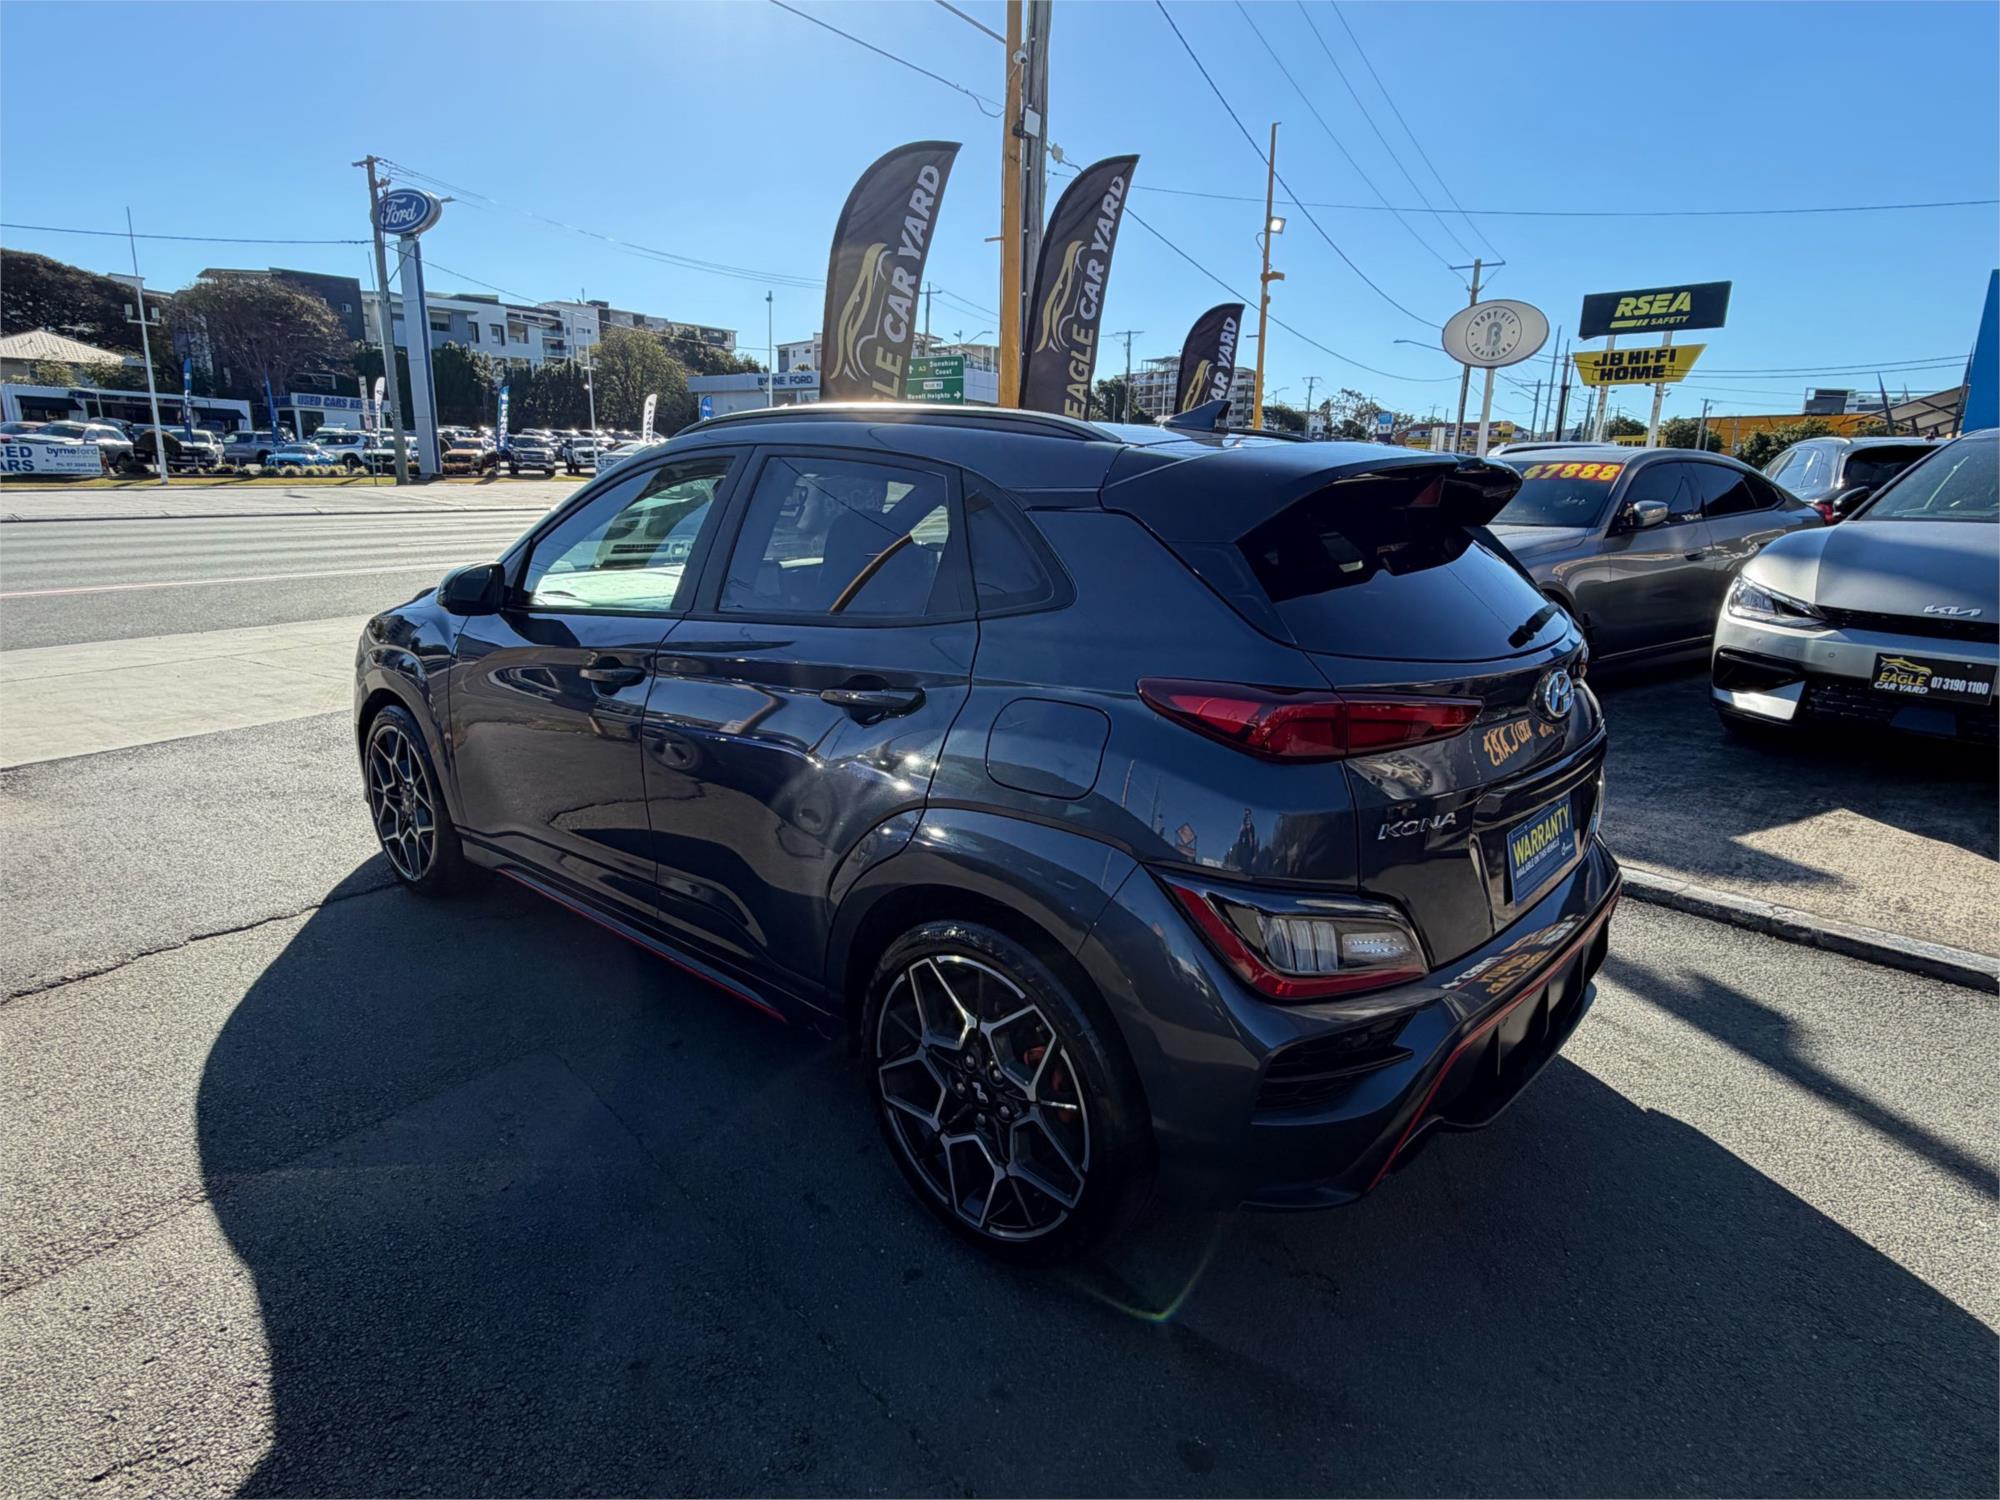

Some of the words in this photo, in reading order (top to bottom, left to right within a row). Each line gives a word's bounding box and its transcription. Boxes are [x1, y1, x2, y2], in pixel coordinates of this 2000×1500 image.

[379, 197, 417, 225] Ford
[898, 165, 940, 261] YARD
[1091, 175, 1125, 253] YARD
[1079, 258, 1105, 320] CAR
[884, 266, 917, 343] CAR
[1614, 292, 1691, 318] RSEA
[1474, 310, 1498, 327] BODY
[1500, 312, 1515, 325] FIT
[1650, 315, 1690, 326] SAFETY
[1217, 316, 1237, 369] YARD
[1594, 352, 1624, 367] JB
[757, 376, 785, 385] BYNE
[789, 375, 813, 384] FORD
[1064, 323, 1094, 420] EAGLE
[1599, 365, 1666, 381] HOME
[1210, 371, 1229, 400] AR
[0, 446, 33, 458] ED
[0, 460, 35, 472] ARS
[1523, 463, 1621, 480] 47888
[1874, 681, 1898, 691] CAR
[1899, 684, 1929, 694] YARD
[1880, 672, 1927, 686] EAGLE
[1931, 676, 1943, 688] 07
[1943, 678, 1965, 692] 3190
[1967, 681, 1989, 695] 1100
[1378, 812, 1457, 840] KONA
[1513, 804, 1569, 867] WARRANTY
